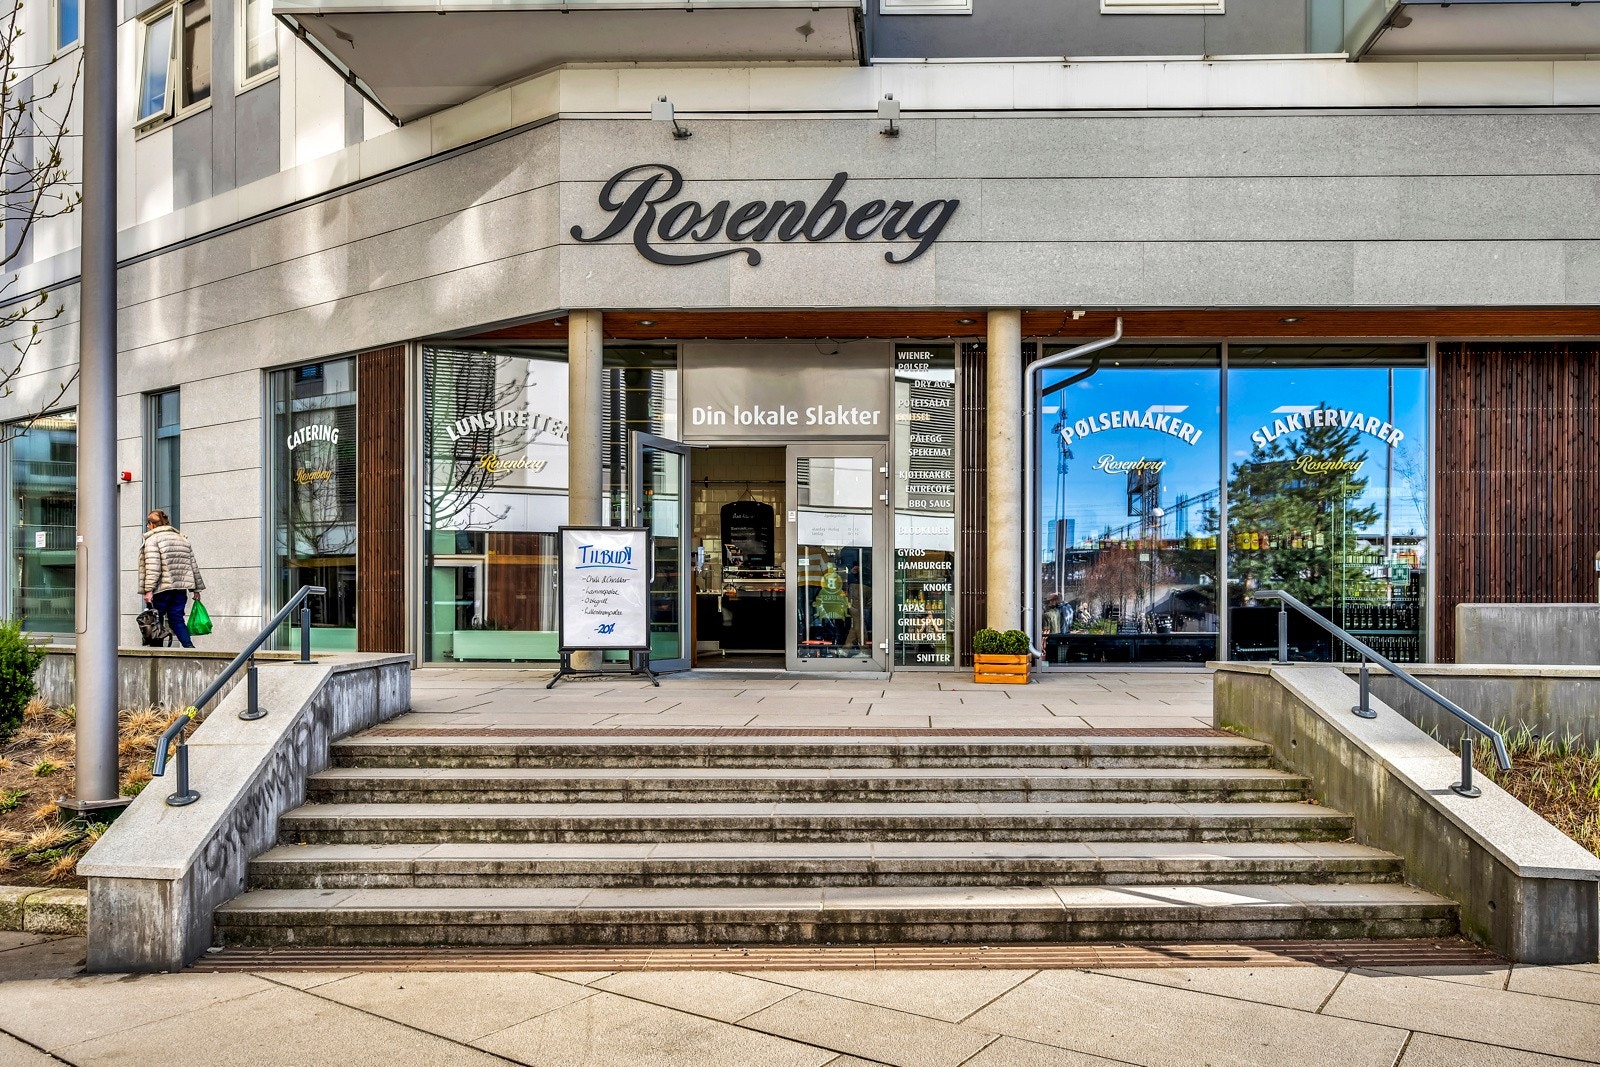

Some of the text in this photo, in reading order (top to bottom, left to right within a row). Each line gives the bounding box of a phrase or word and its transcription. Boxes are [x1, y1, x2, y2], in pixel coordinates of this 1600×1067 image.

[570, 163, 961, 267] Rosenberg
[692, 405, 881, 426] Din lokale Slakter
[1060, 410, 1204, 446] PØLSEMAKERI
[1251, 409, 1405, 449] SLAKTERVARER
[287, 425, 340, 451] CATERING
[908, 448, 952, 457] SPEKEMAT
[475, 453, 547, 474] Rosenberg
[1092, 454, 1167, 475] Rosenberg
[1291, 454, 1365, 475] Rosenberg
[293, 467, 333, 485] Rosenberg
[905, 484, 952, 494] ENTRECOTE
[908, 499, 951, 510] BBQ SAUS
[578, 545, 632, 564] TILBUD!
[898, 549, 926, 557] GYROS
[898, 562, 952, 570] HAMBURGER
[923, 584, 952, 592] KNOKE
[898, 604, 925, 612] TAPAS
[898, 618, 943, 626] GRILLSPYD
[898, 633, 947, 641] GRILLPØLSE
[916, 654, 951, 662] SNITTER
